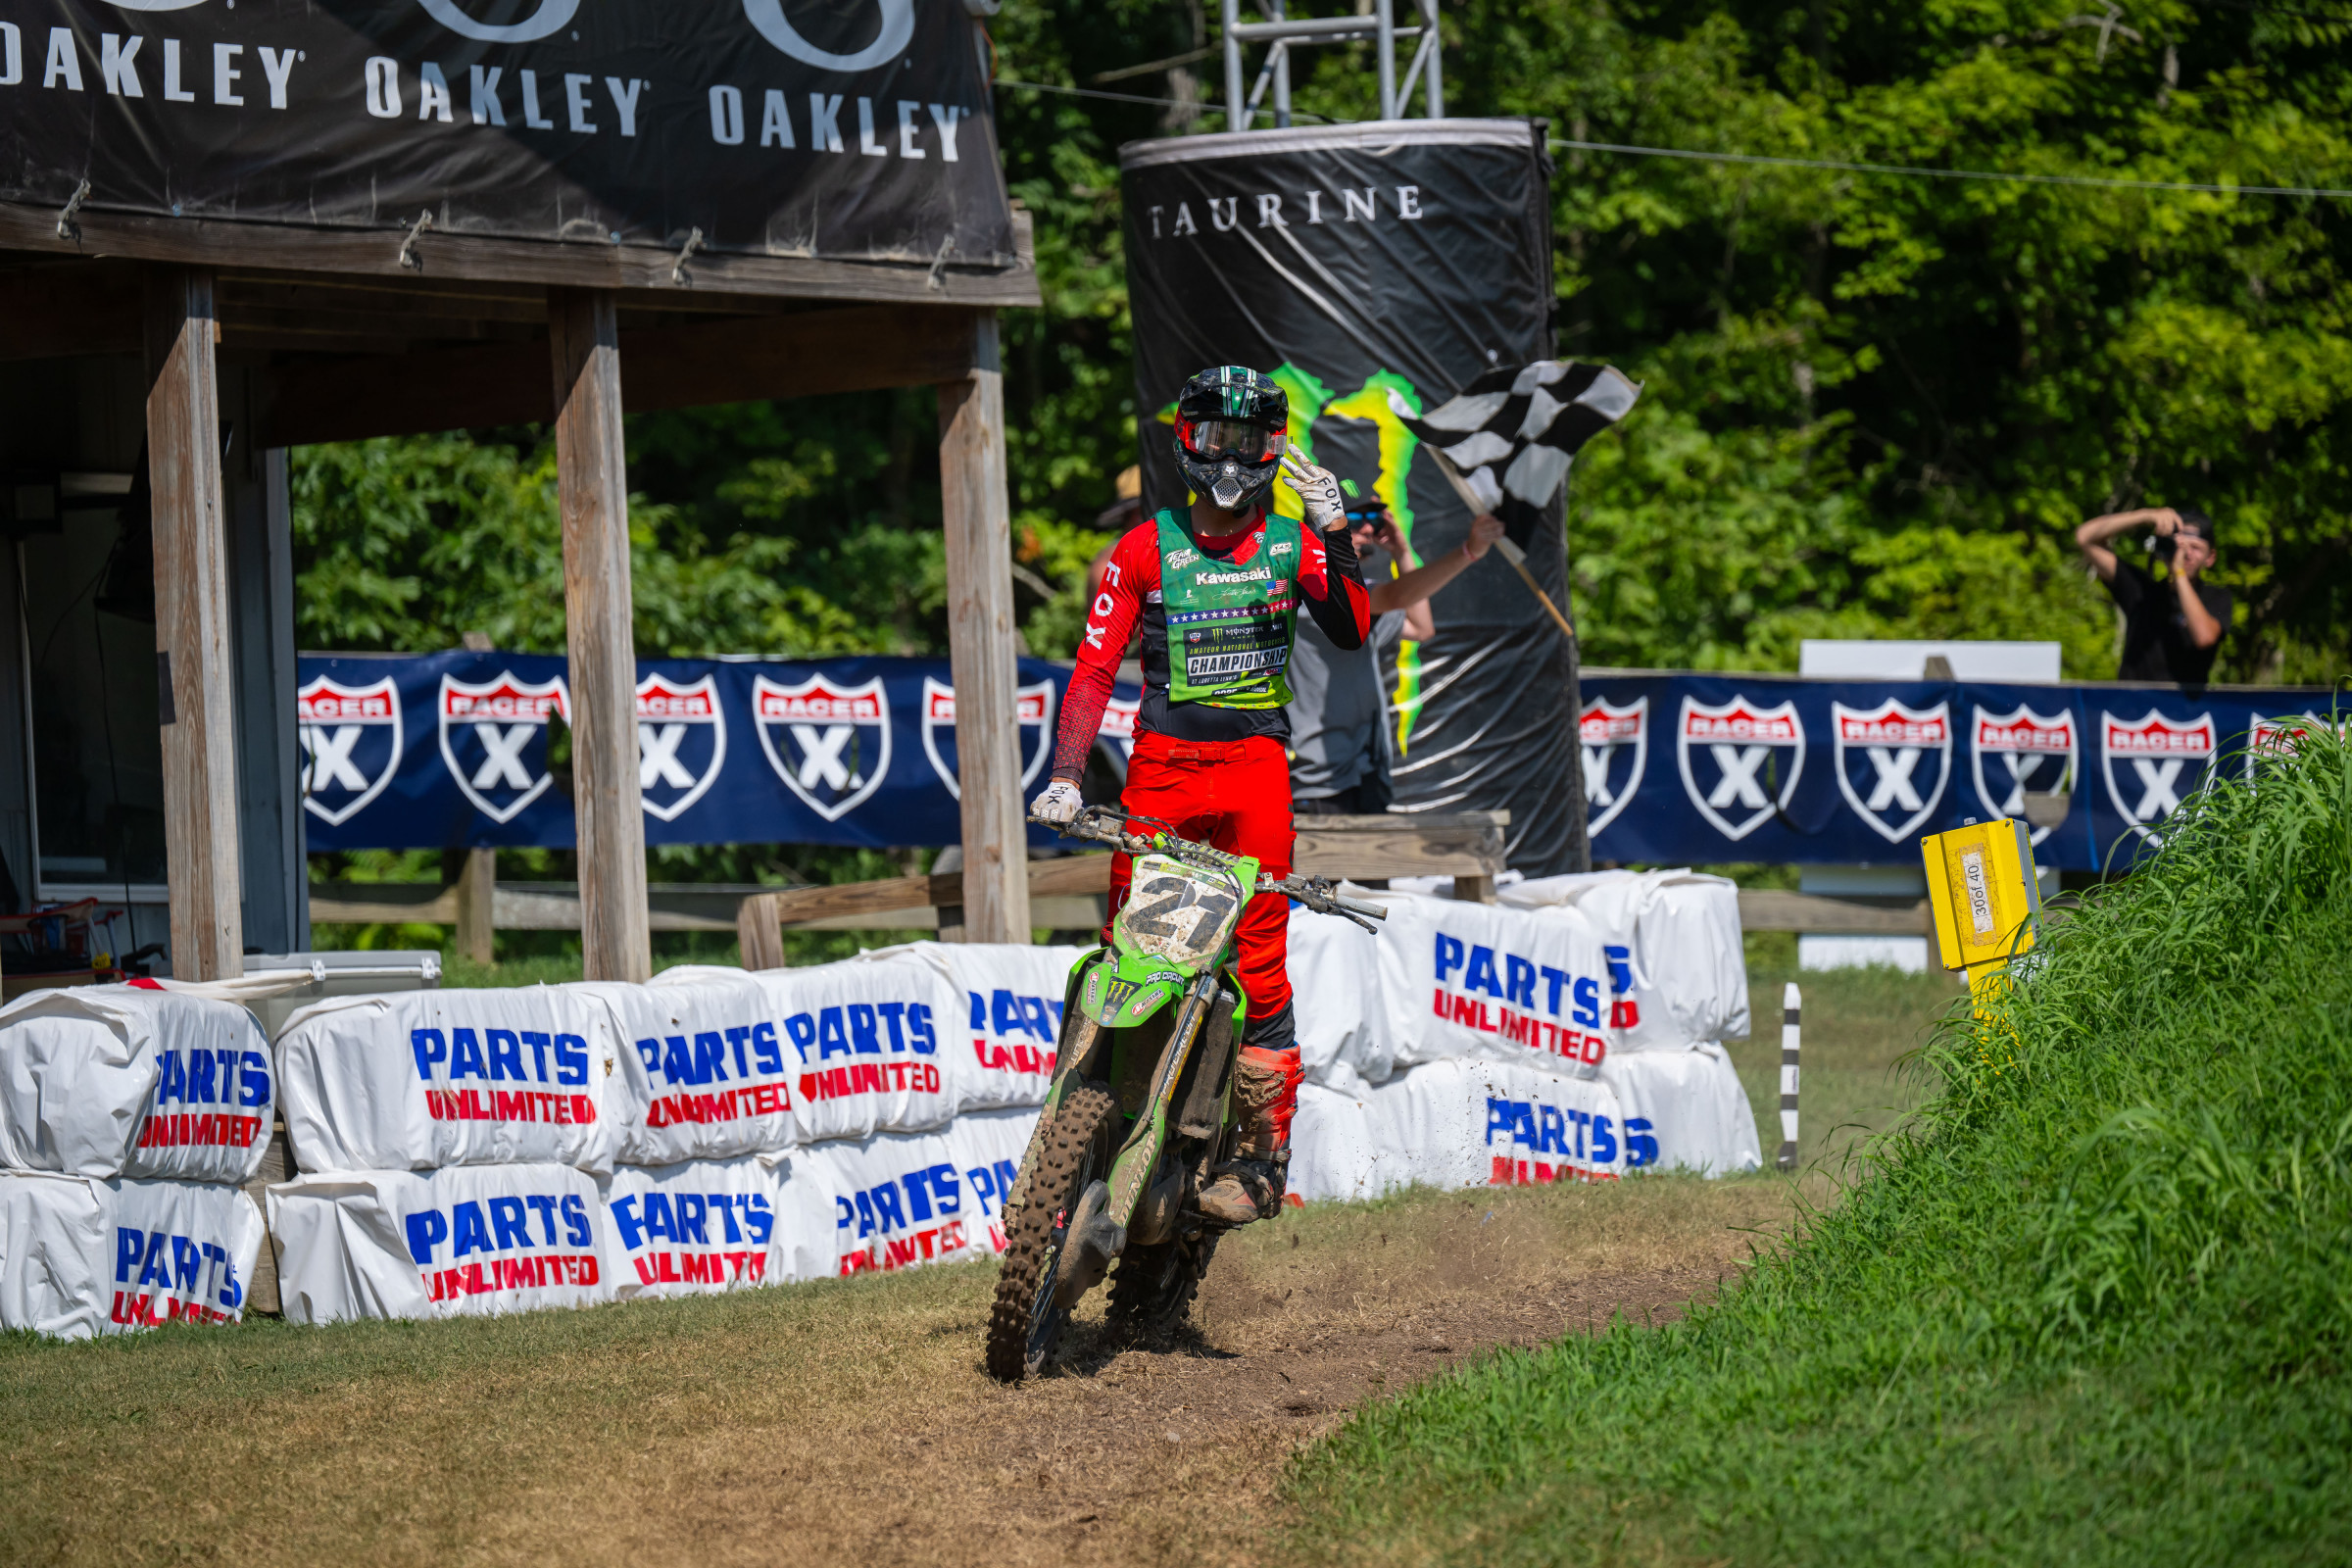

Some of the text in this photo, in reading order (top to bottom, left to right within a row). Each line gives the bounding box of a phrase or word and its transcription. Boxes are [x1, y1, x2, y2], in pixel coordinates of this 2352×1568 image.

[365, 55, 643, 137] OAKLEY
[709, 84, 960, 163] OAKLEY
[1147, 185, 1424, 240] TAURINE
[1317, 476, 1343, 513] FOX
[1165, 549, 1192, 564] TEAM
[1173, 554, 1200, 569] GREEN
[1196, 565, 1272, 586] Kawasaki
[1086, 561, 1121, 651] FOX
[1190, 648, 1287, 674] CHAMPIONSHIP
[298, 698, 385, 717] ACER
[763, 698, 877, 717] RACER
[1690, 718, 1791, 738] RACER
[1844, 720, 1941, 741] RACER
[1983, 727, 2067, 747] RACER
[471, 723, 538, 790] X
[2112, 731, 2207, 752] RACER
[1707, 745, 1772, 808] X
[1866, 747, 1925, 811] X
[2132, 759, 2188, 821] X
[1128, 876, 1237, 954] 21
[1146, 971, 1184, 987] PRO CIRCUIT
[1436, 932, 1600, 1029] PARTS
[411, 1027, 590, 1086] PARTS
[635, 1021, 785, 1091] PARTS
[784, 1002, 937, 1065] PARTS
[1434, 988, 1606, 1066] UNLIMITED
[425, 1090, 597, 1125] UNLIMITED
[1487, 1097, 1617, 1163] PARTS
[404, 1195, 594, 1265] PARTS
[836, 1163, 960, 1241] PARTS
[116, 1227, 242, 1309] PARTS
[421, 1254, 600, 1303] UNLIMITED
